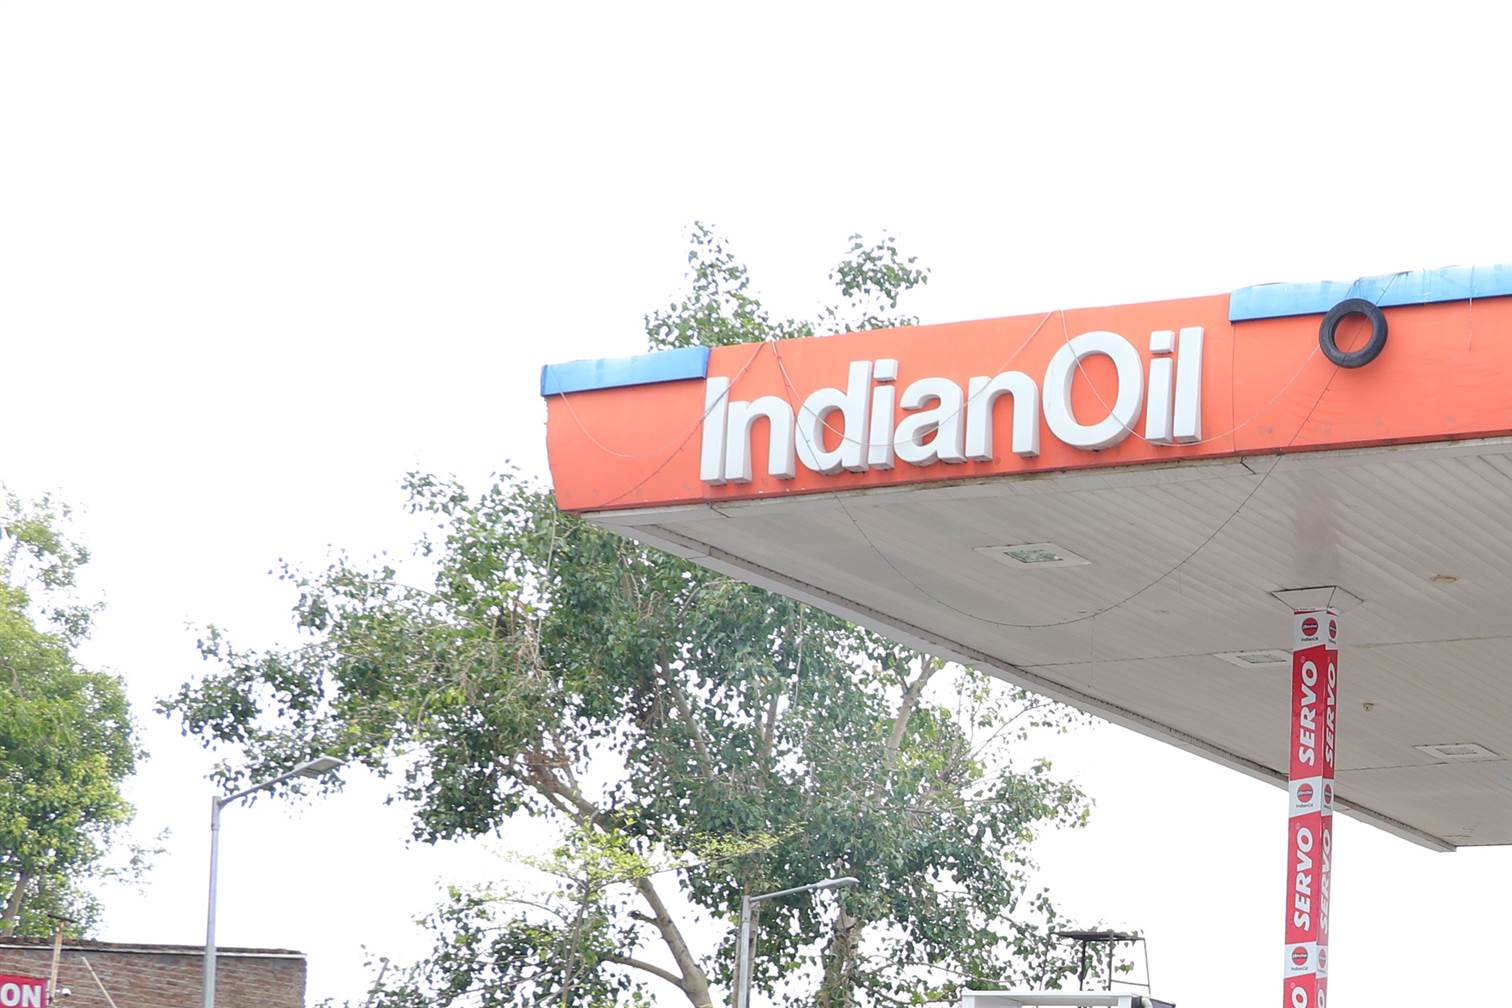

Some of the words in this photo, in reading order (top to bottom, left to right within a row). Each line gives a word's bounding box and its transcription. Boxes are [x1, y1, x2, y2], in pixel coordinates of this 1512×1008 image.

[700, 326, 1204, 487] IndianOil
[1299, 661, 1318, 766] SERVO
[1325, 662, 1336, 768] SERVO
[1294, 826, 1314, 931] SERVO
[1320, 828, 1331, 934] SERVO
